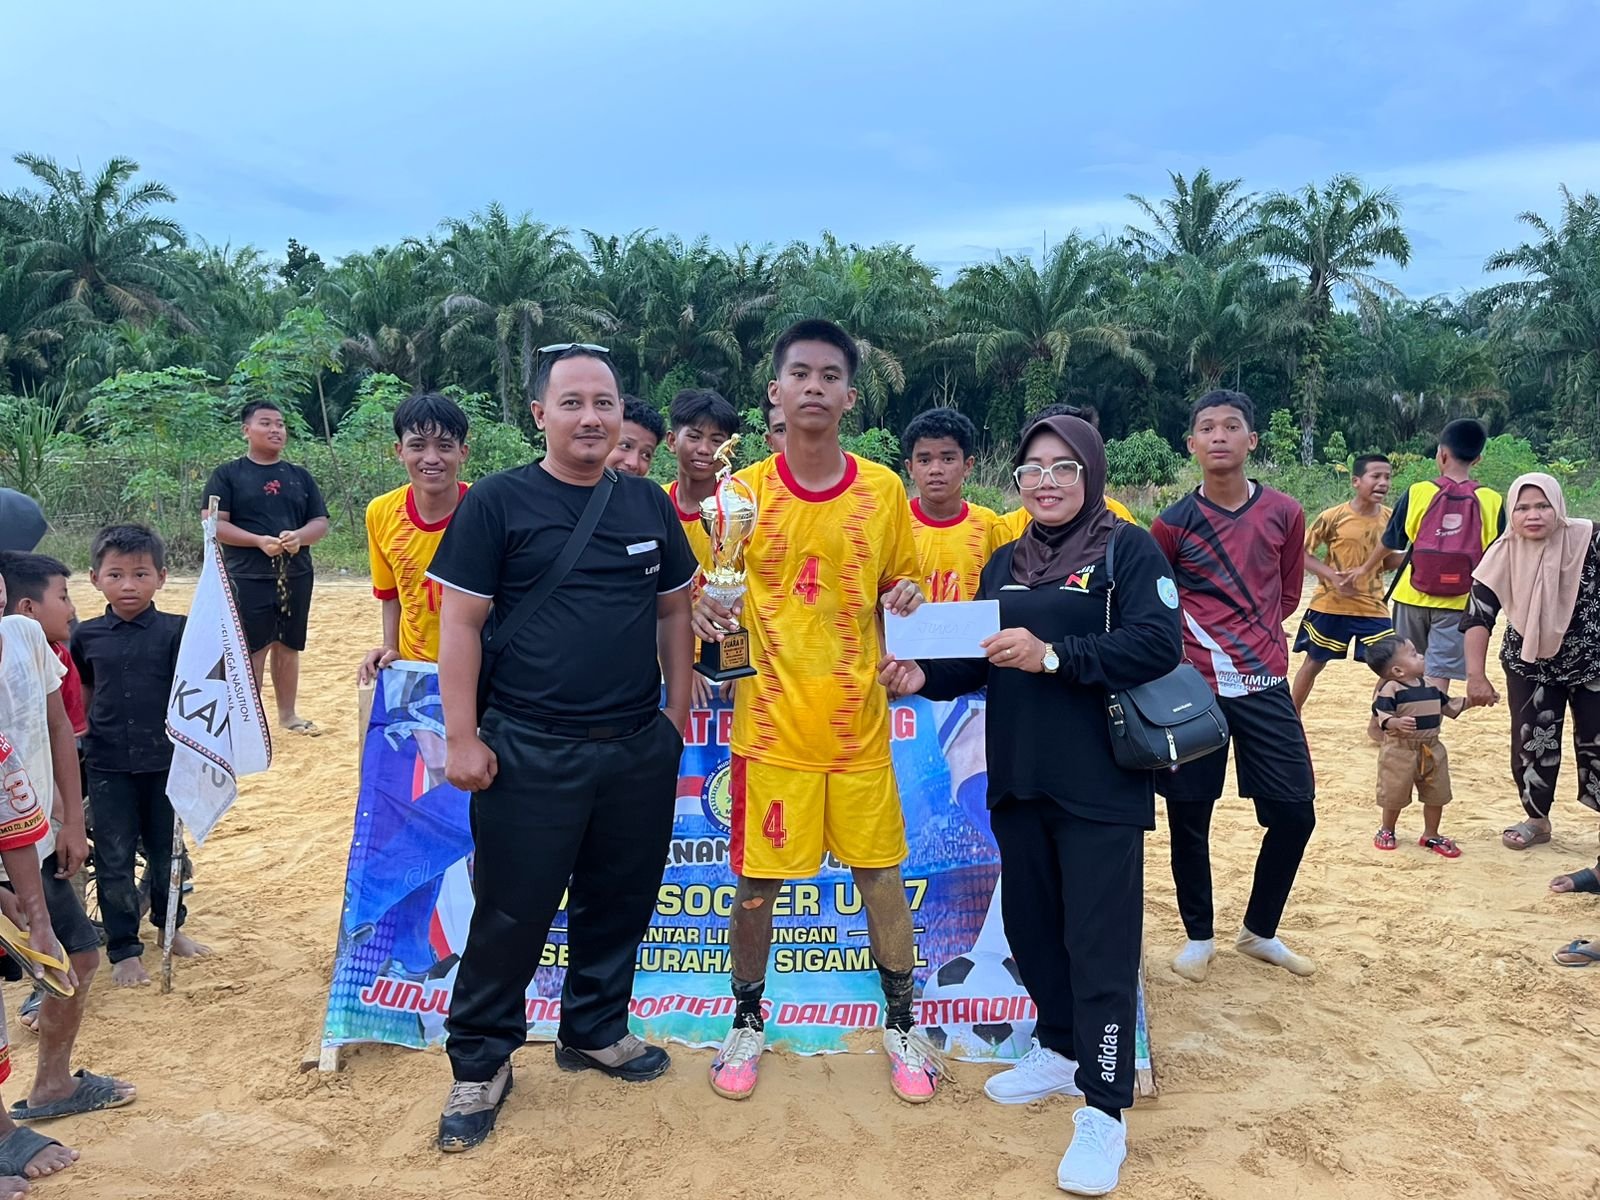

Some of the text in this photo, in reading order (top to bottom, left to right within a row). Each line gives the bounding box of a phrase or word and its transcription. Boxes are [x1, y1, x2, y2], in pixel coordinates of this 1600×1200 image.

[793, 556, 819, 605] 4
[232, 673, 250, 722] NASUTION
[762, 800, 787, 848] 4
[642, 927, 699, 943] NTAR
[777, 1003, 878, 1026] DALAM
[1098, 1023, 1119, 1083] adidas
